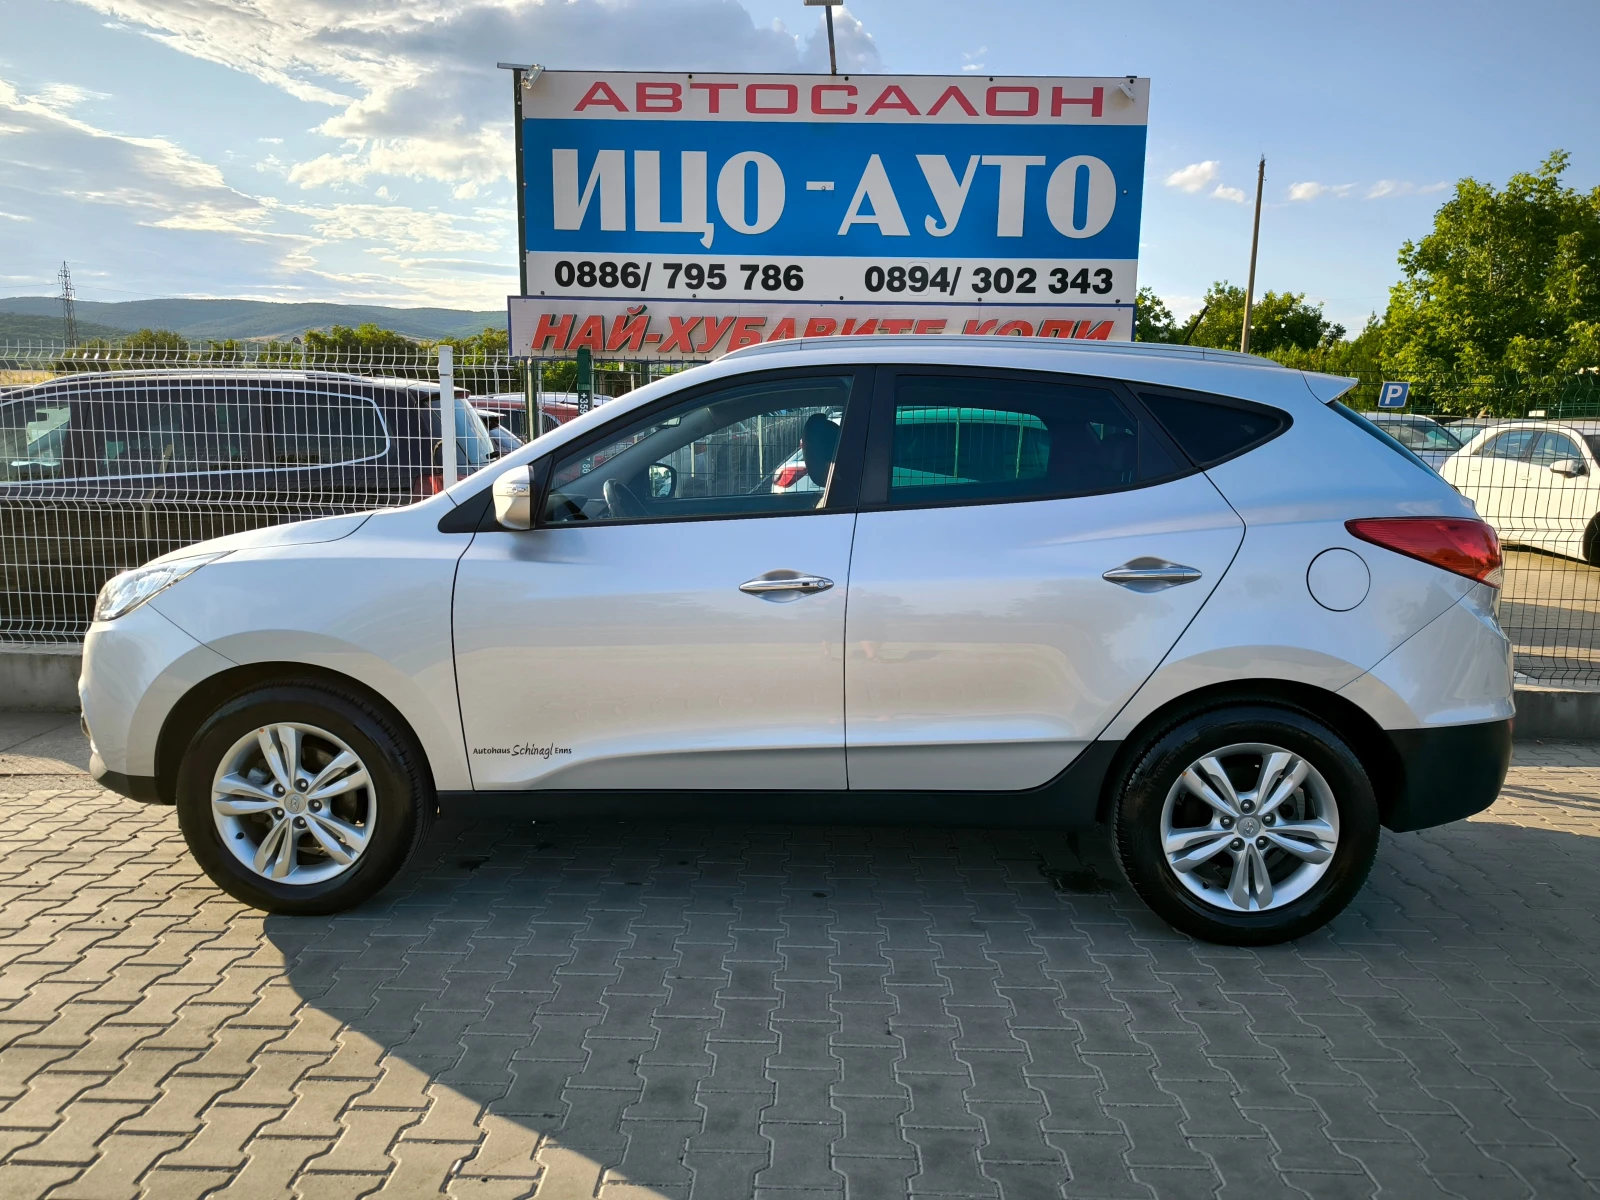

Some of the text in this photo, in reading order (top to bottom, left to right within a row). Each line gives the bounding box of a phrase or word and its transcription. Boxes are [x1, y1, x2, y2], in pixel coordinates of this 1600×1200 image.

[573, 81, 1104, 118] АВТОСАЛОН
[554, 260, 1113, 296] 0886/ 795 786 0894/ 302 343
[1385, 385, 1403, 404] P
[473, 742, 572, 759] Autohaus Schinagl Enns
